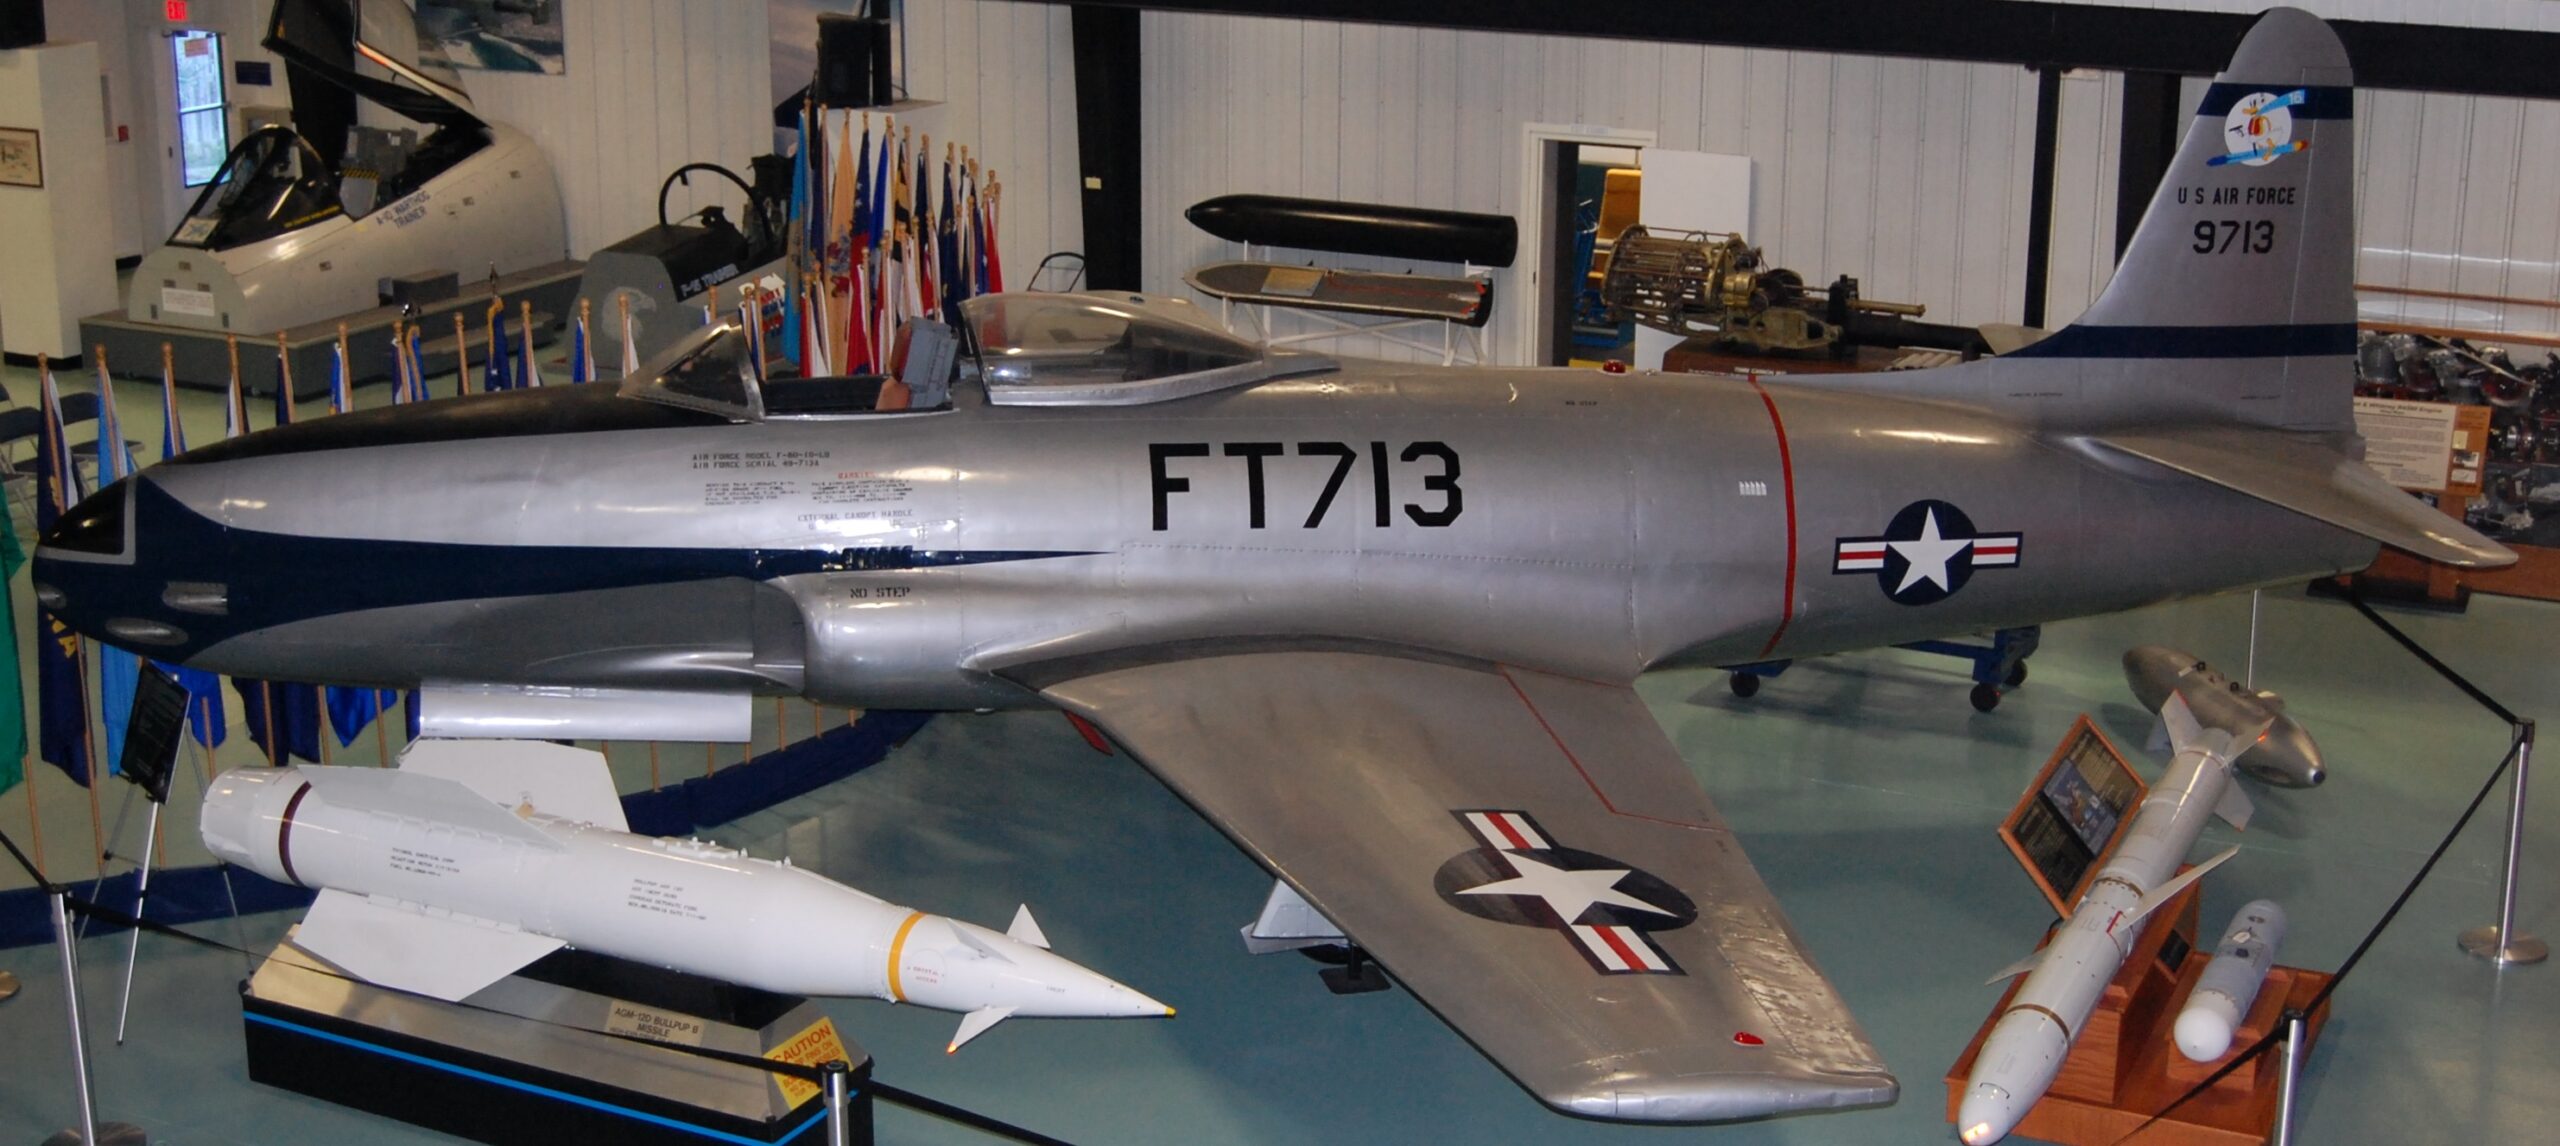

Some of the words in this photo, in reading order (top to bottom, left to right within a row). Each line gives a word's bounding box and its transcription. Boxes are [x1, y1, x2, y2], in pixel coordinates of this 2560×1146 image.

[2177, 187, 2188, 204] U
[2195, 187, 2205, 205] S
[2213, 187, 2239, 205] AIR
[2247, 187, 2297, 205] FORCE
[2193, 220, 2275, 254] 9713
[693, 453, 709, 461] AIR
[693, 462, 709, 470] AIR
[713, 461, 740, 469] FORCE
[1149, 441, 1463, 531] FT713
[850, 587, 868, 600] NO
[876, 586, 911, 599] STEP
[637, 1023, 671, 1038] MISSILE
